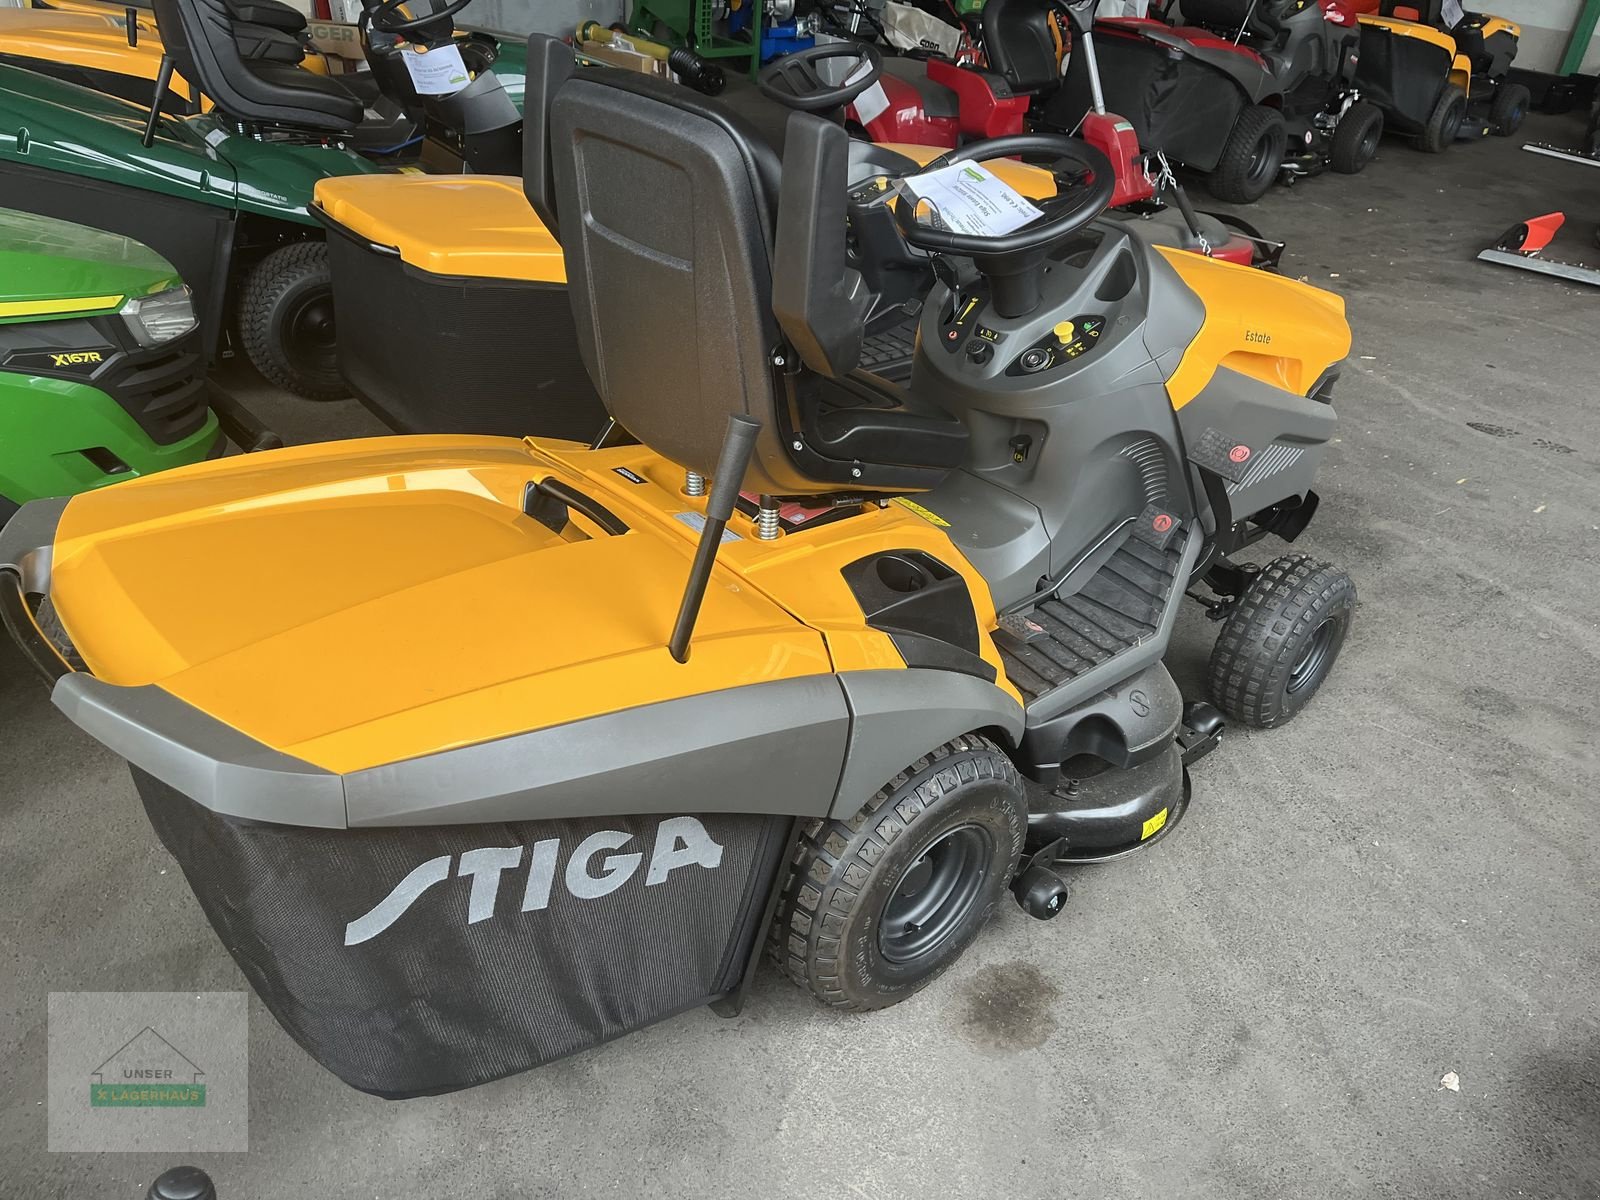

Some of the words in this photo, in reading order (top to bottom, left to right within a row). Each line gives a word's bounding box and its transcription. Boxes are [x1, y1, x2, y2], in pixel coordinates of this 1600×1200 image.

[1245, 330, 1271, 344] Estate
[49, 351, 104, 366] X167R
[344, 816, 724, 946] STIGA
